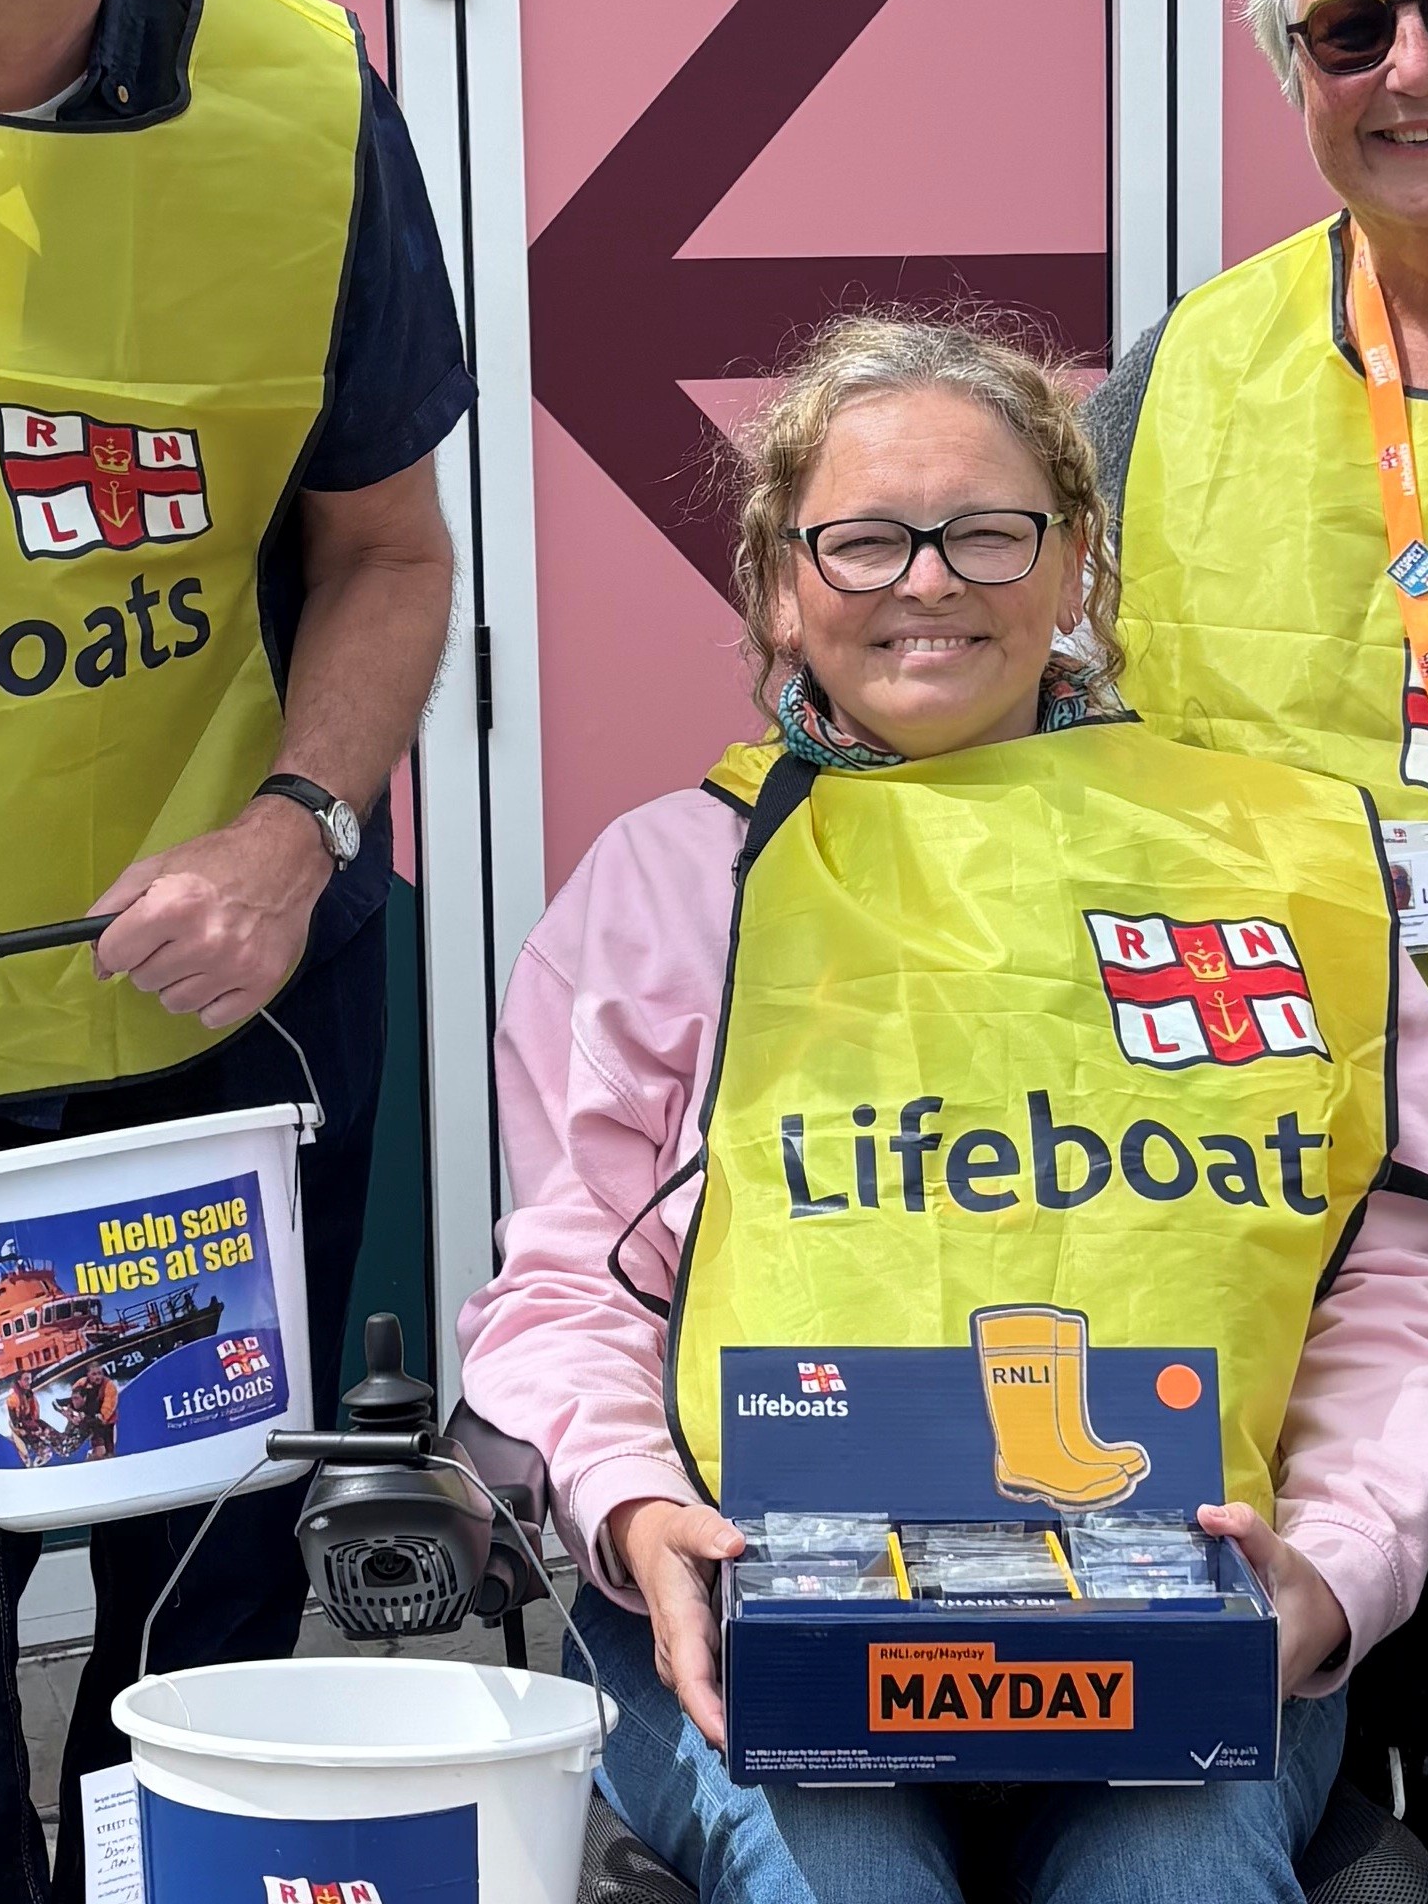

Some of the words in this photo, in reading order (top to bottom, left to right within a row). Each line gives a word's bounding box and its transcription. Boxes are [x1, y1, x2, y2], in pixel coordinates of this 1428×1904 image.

[26, 415, 58, 448] R
[154, 434, 183, 463] N
[41, 501, 78, 543] L
[1113, 921, 1147, 961] R
[1245, 924, 1277, 958] N
[1141, 1012, 1180, 1054] L
[99, 1212, 177, 1258] Help
[184, 1196, 248, 1240] save
[74, 1256, 159, 1296] lives
[165, 1246, 198, 1282] at
[204, 1231, 254, 1274] sea
[991, 1365, 1051, 1386] RNLI
[162, 1375, 274, 1421] Lifeboats
[737, 1393, 849, 1417] Lifeboats
[880, 1646, 985, 1661] RNLI.org/Mayday
[880, 1672, 1124, 1720] MAYDAY
